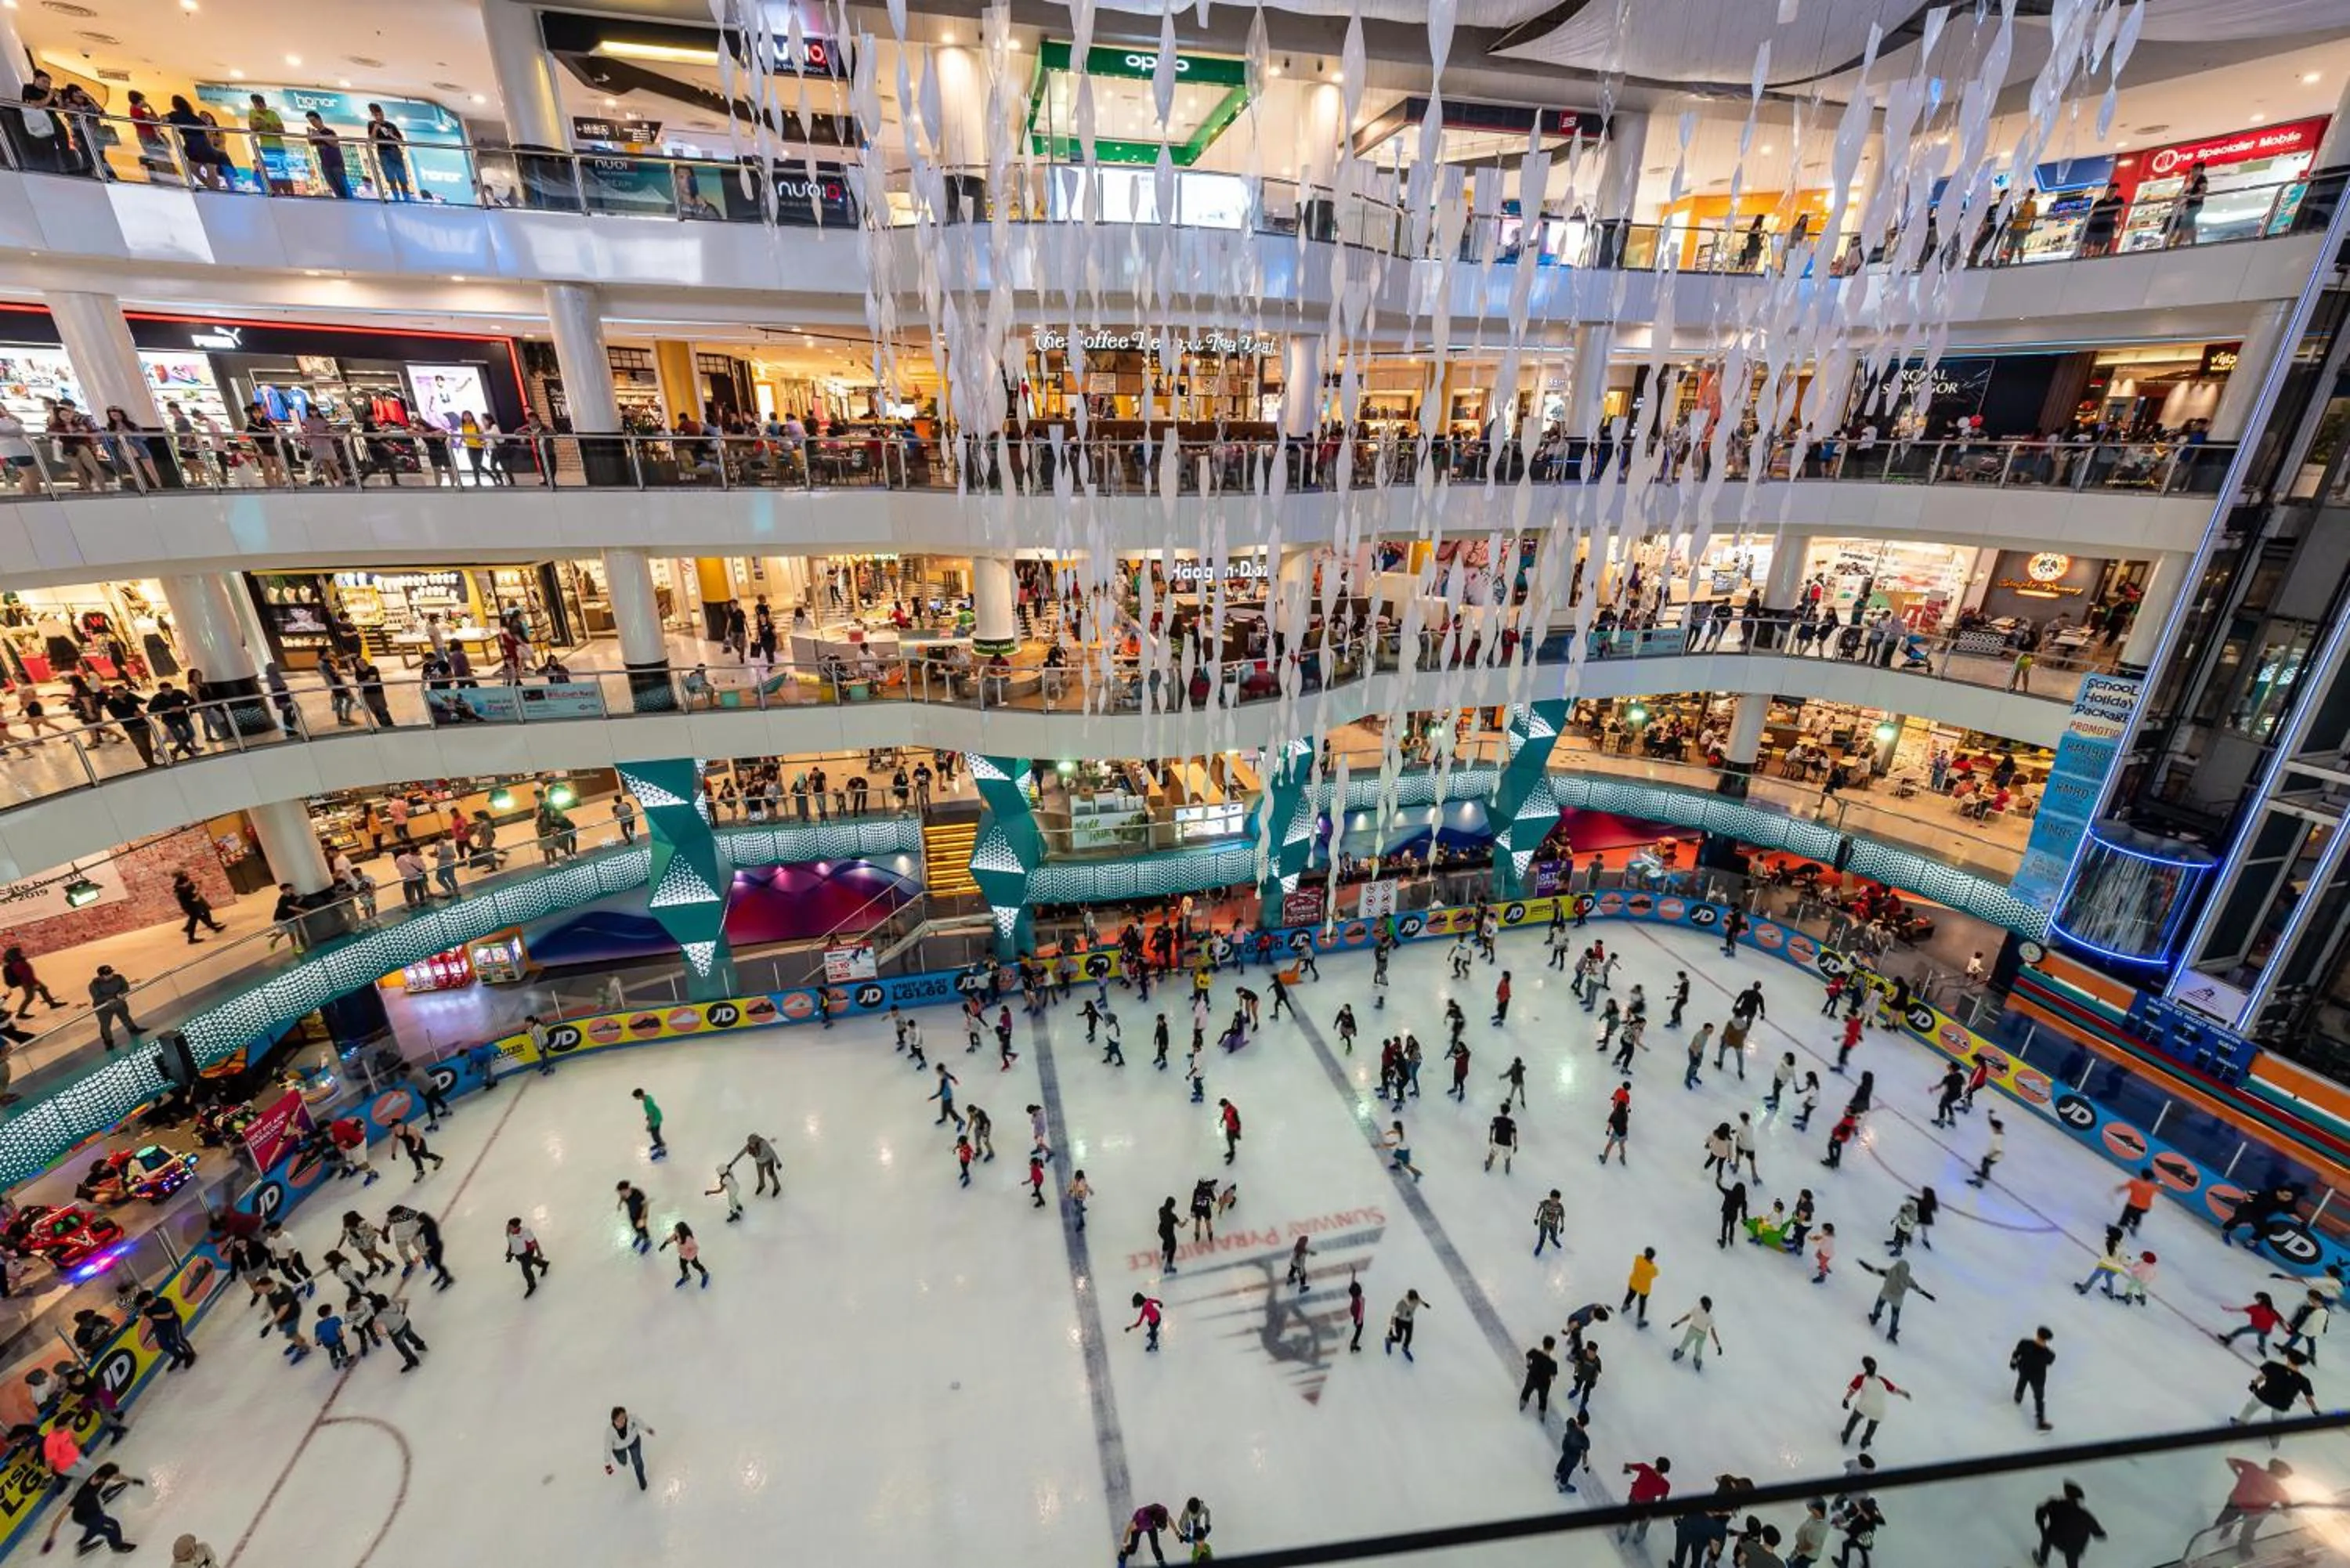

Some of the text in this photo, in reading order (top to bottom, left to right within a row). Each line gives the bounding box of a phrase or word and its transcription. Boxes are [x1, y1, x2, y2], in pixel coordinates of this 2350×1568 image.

[1126, 55, 1189, 71] opo
[2258, 132, 2302, 147] Mobile
[1077, 330, 1128, 349] offee
[2069, 720, 2122, 738] PROMOTIO
[1505, 907, 1524, 919] JD
[1697, 909, 1716, 923] JD
[1401, 922, 1419, 933] JD
[1820, 957, 1841, 974] JD
[859, 988, 882, 1003] JD
[711, 1006, 736, 1024] JD
[1907, 1010, 1933, 1028] JD
[550, 1030, 578, 1050] JD
[2059, 1102, 2093, 1125] JD
[259, 1185, 280, 1216] JD
[1287, 1205, 1386, 1237] SUNWAY
[2269, 1229, 2316, 1257] JD
